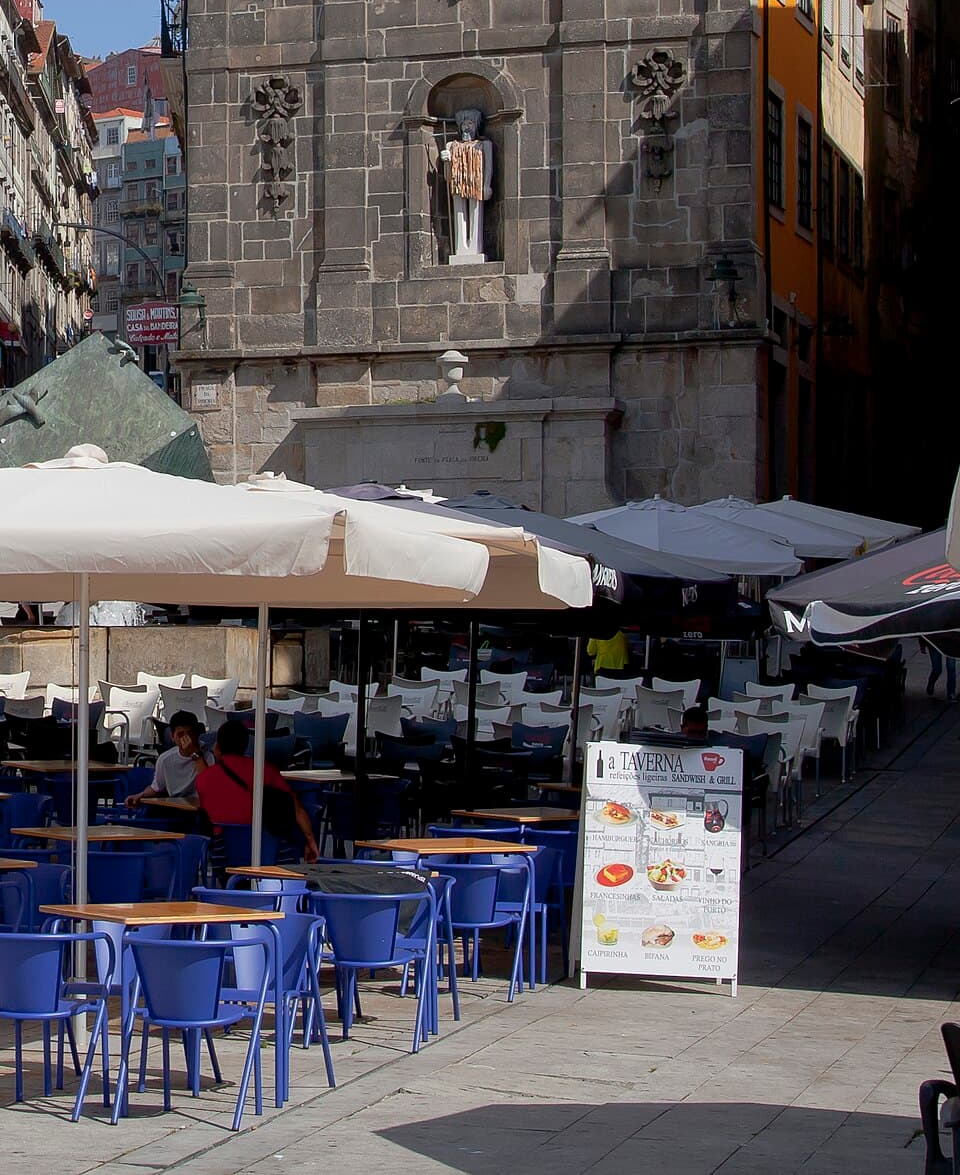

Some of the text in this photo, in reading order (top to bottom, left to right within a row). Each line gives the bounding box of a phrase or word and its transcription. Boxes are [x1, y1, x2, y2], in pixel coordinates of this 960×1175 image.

[127, 323, 144, 332] CASA
[608, 751, 684, 773] a TAVERNA
[609, 771, 736, 785] refeições ligeiras SANDWISH & GRILL
[590, 892, 641, 902] FRANCESINHAS
[651, 894, 683, 903] SALADAS
[698, 897, 732, 906] VINHO DO
[587, 949, 628, 959] CAIPIRINHA
[644, 952, 670, 961] BIFANA
[692, 954, 715, 963] PREGO
[698, 964, 721, 972] PRATO
